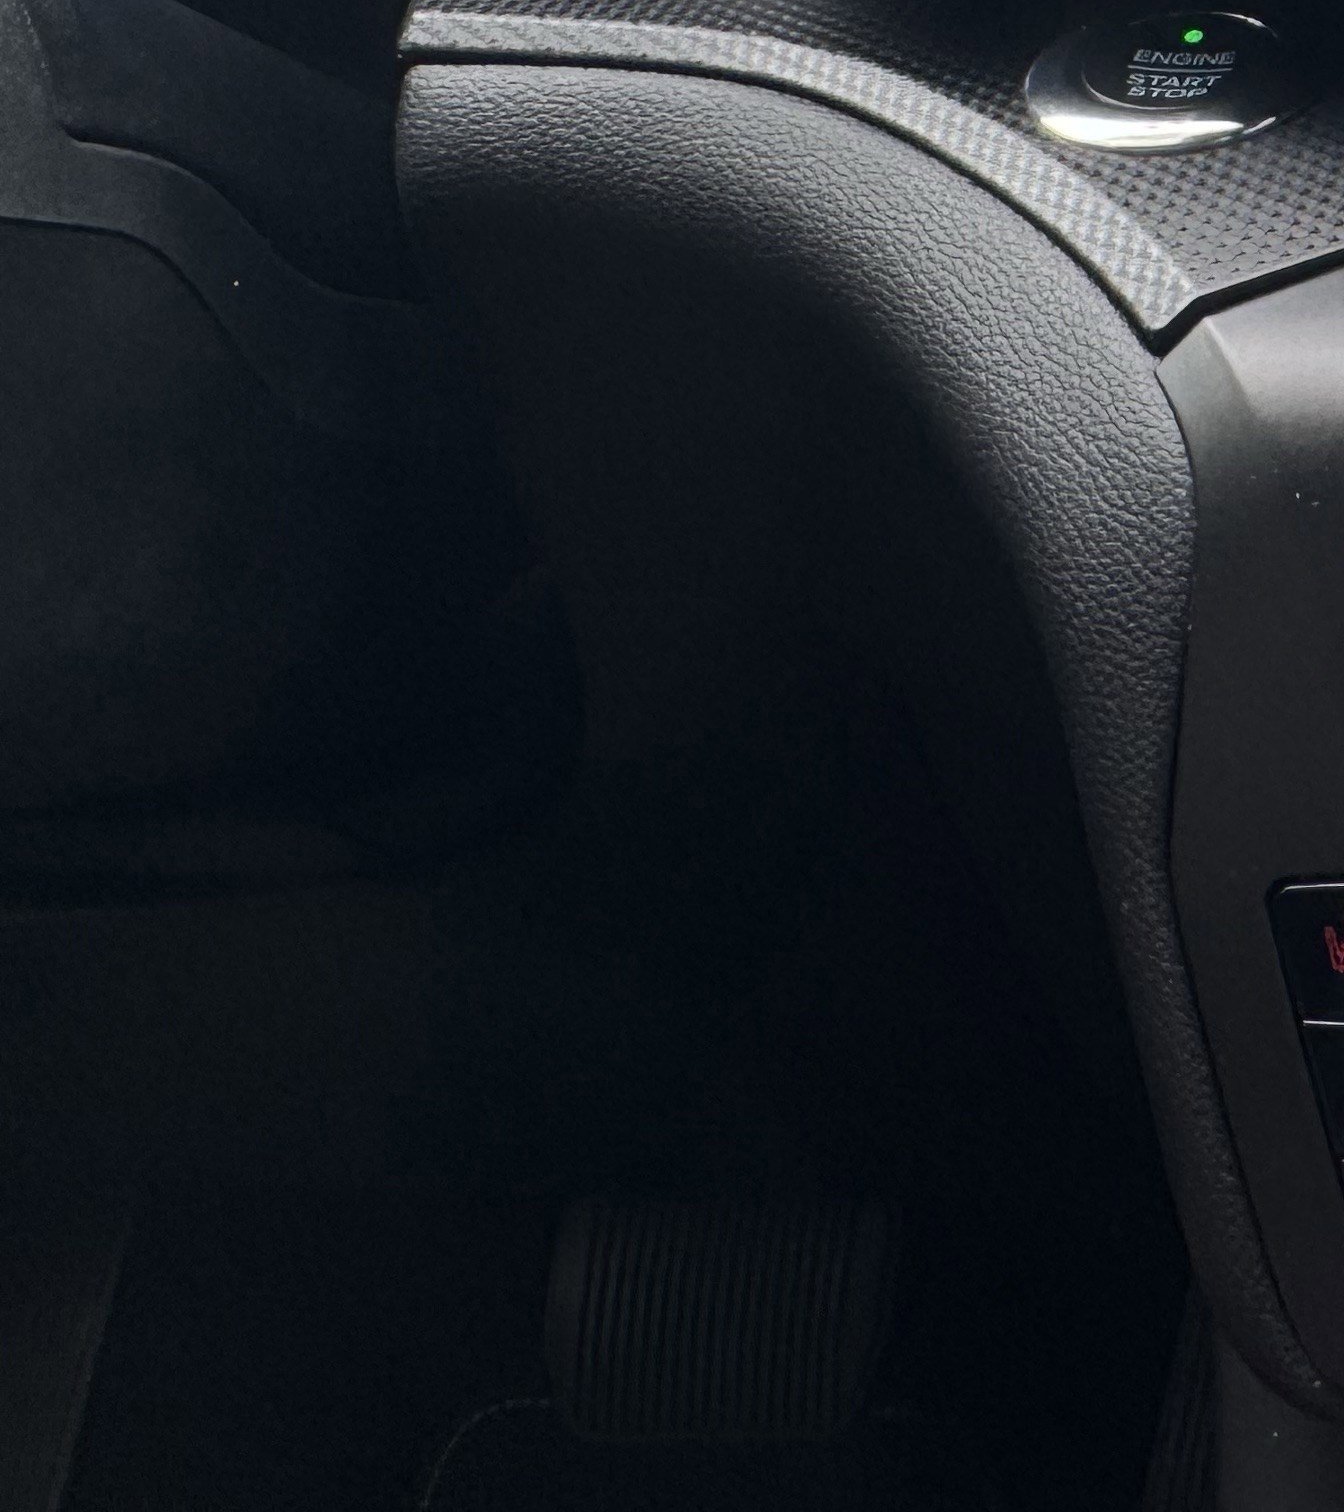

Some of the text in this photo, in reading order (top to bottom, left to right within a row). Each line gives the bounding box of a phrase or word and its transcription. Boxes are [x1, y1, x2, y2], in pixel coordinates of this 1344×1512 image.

[1132, 48, 1236, 66] ENGINE
[1126, 73, 1223, 87] START
[1126, 87, 1209, 98] STOP
